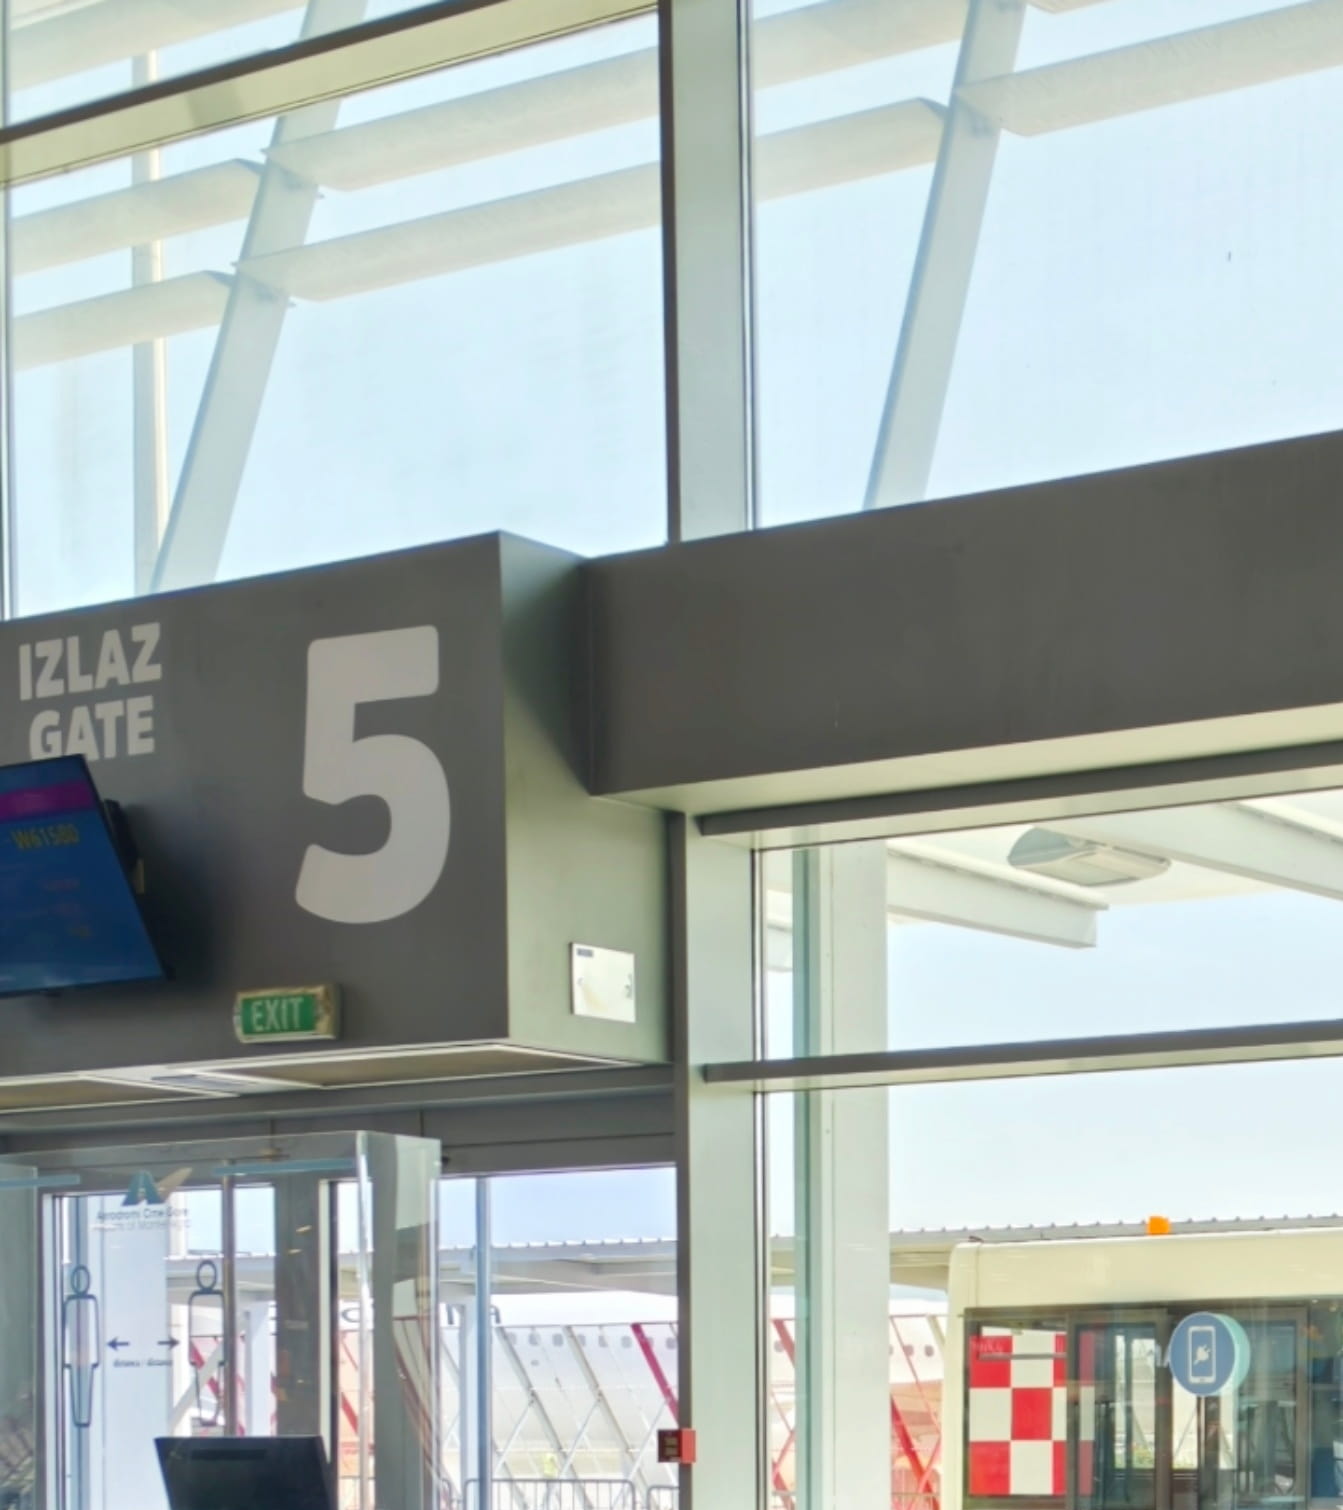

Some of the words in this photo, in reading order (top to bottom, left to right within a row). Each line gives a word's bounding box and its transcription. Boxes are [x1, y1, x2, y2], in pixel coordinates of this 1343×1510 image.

[19, 622, 162, 701] IZLAZ
[29, 695, 155, 762] GATE
[296, 625, 450, 924] 5
[250, 996, 304, 1033] EXIT
